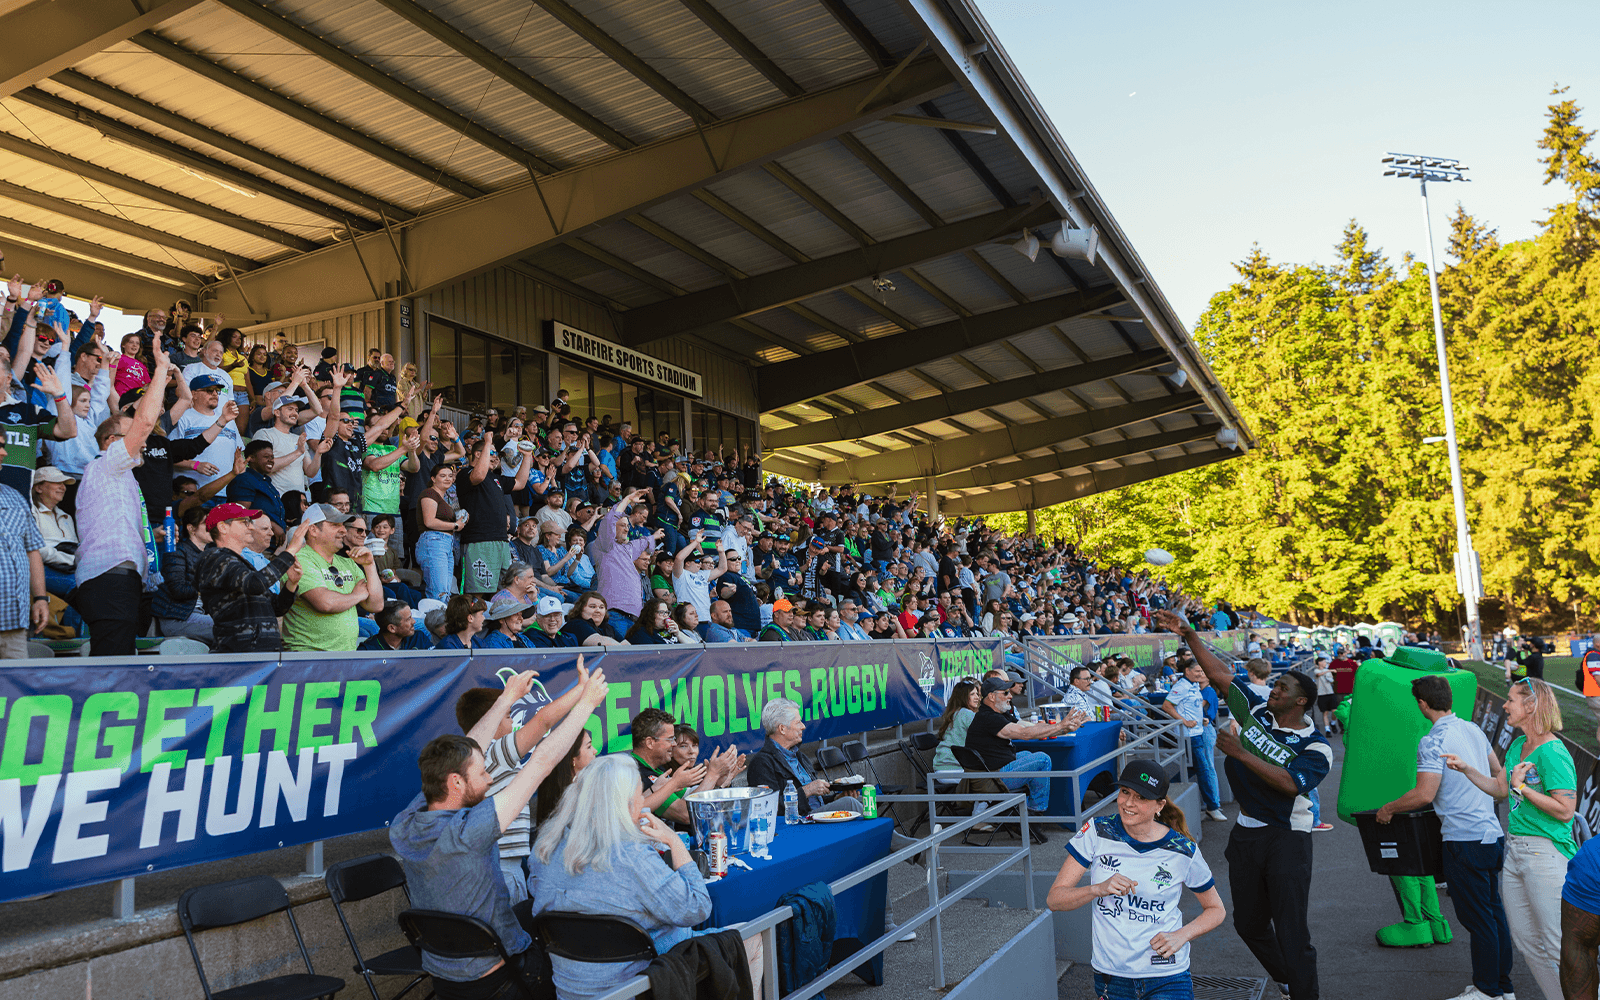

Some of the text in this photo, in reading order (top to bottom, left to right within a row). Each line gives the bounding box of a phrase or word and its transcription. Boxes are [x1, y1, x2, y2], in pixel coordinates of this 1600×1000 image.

[562, 329, 697, 392] STARFIRE SPORTS STADIUM
[6, 431, 31, 447] TLE
[940, 648, 994, 681] TOGETHER
[0, 679, 382, 787] OGETHER
[139, 743, 358, 849] HUNT
[710, 842, 718, 869] TAVERN
[1128, 894, 1166, 912] WaFd
[1128, 909, 1161, 925] Bank
